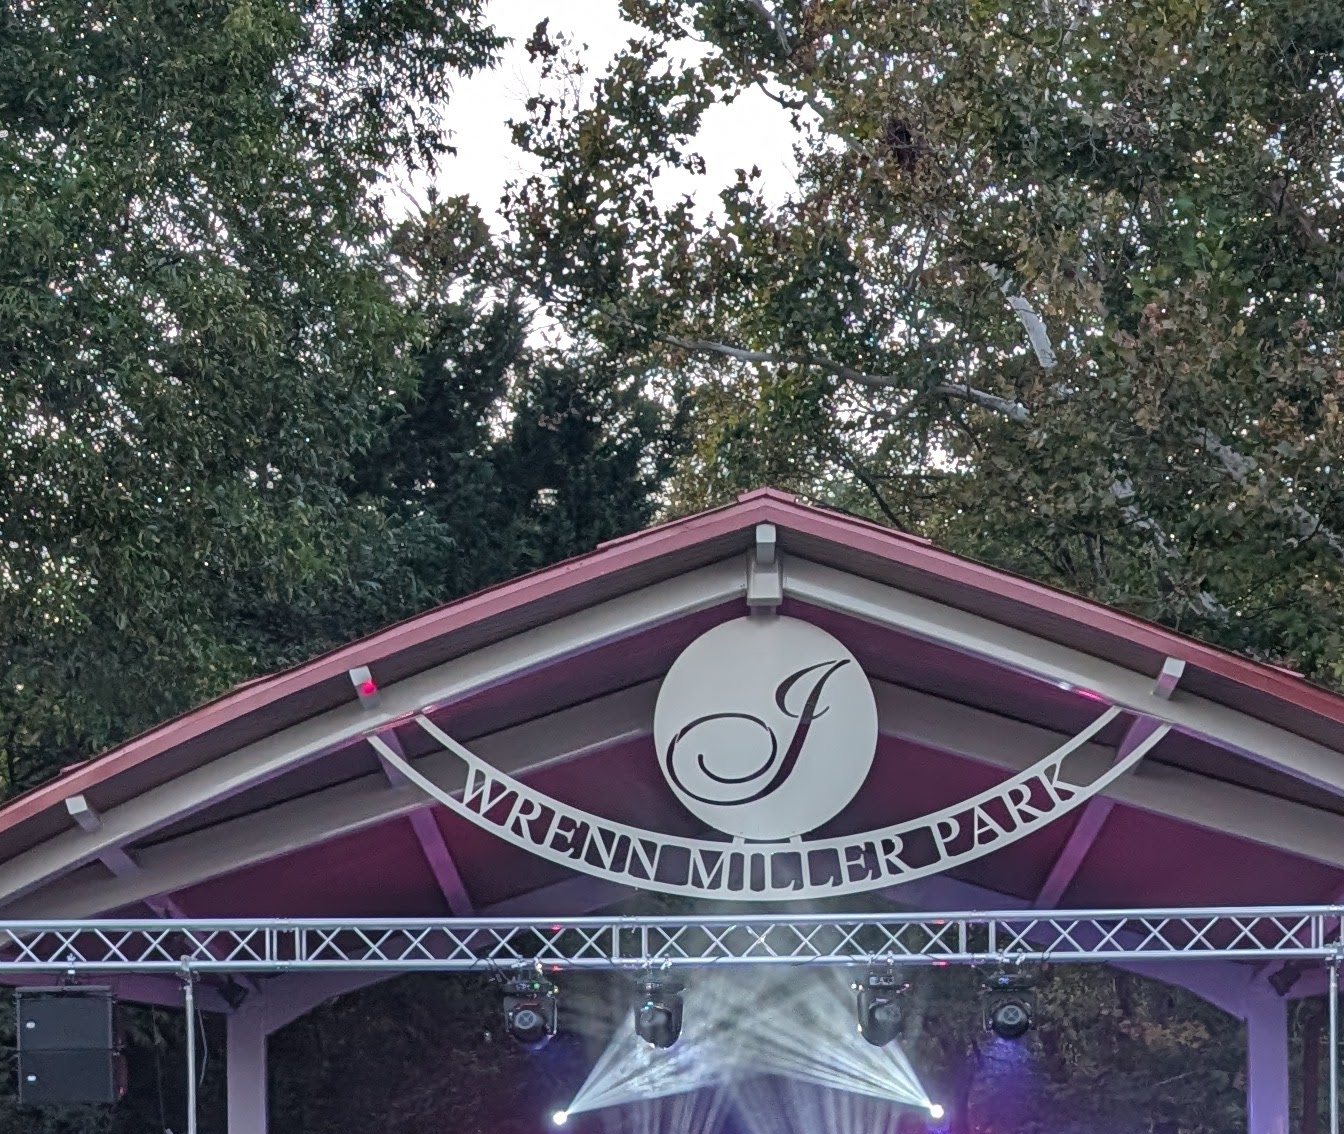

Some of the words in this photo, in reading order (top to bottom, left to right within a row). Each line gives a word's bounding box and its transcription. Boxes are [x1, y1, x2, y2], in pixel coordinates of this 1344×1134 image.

[462, 759, 660, 883] WRENN
[689, 835, 908, 893] MILLER
[931, 762, 1090, 859] PARK
